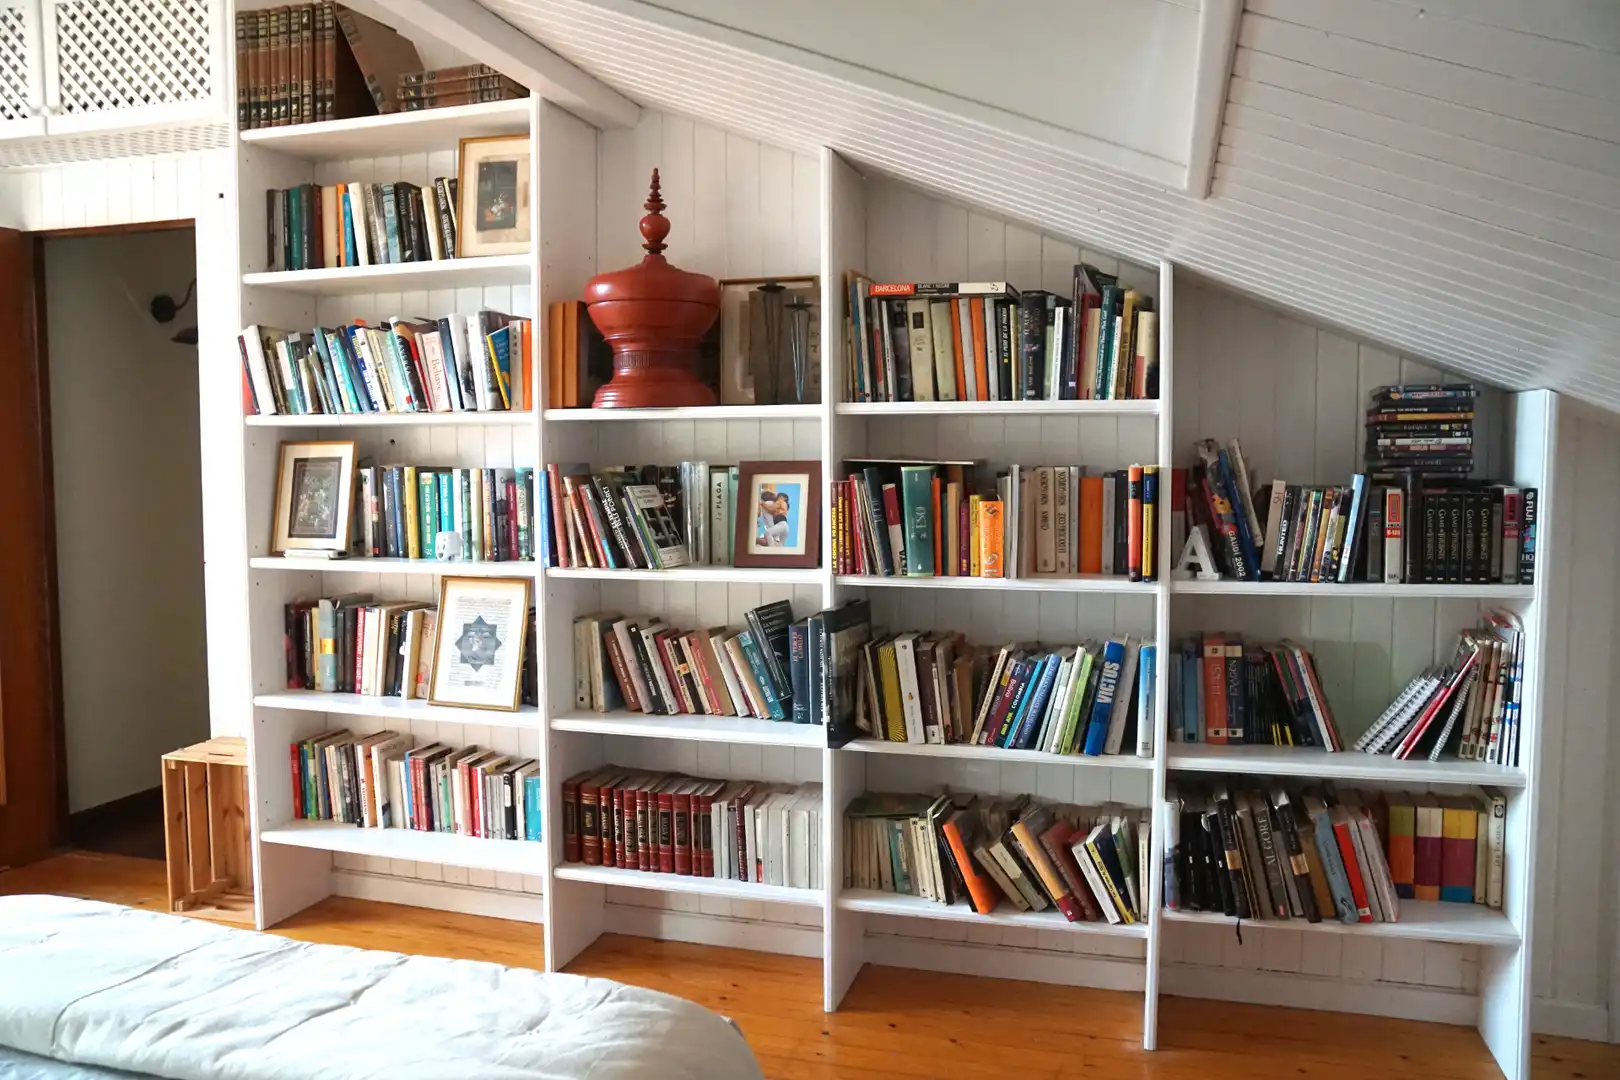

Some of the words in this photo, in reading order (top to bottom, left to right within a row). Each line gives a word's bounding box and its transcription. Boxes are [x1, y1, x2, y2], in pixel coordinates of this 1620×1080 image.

[875, 285, 911, 293] BARCELONA
[431, 357, 441, 393] Behave
[916, 506, 927, 529] ESO
[1438, 508, 1446, 528] GAME
[1451, 508, 1459, 528] GAME
[1466, 508, 1474, 528] GAME
[1480, 508, 1489, 528] GAME
[1525, 501, 1535, 521] FUJI
[1278, 520, 1288, 554] HUNTED
[1438, 532, 1446, 560] THRONES
[1451, 532, 1459, 560] THRONES
[1466, 532, 1474, 560] THRONES
[1480, 532, 1489, 560] THRONES
[832, 560, 837, 569] LA
[1173, 526, 1221, 580] A
[1227, 530, 1240, 555] GAUDÍ
[1234, 556, 1246, 577] 2002
[1521, 553, 1535, 561] HQ
[1011, 682, 1025, 709] COLOMBIA
[1097, 661, 1119, 704] VICTUS
[1258, 813, 1273, 848] GORE
[1266, 850, 1276, 866] AL
